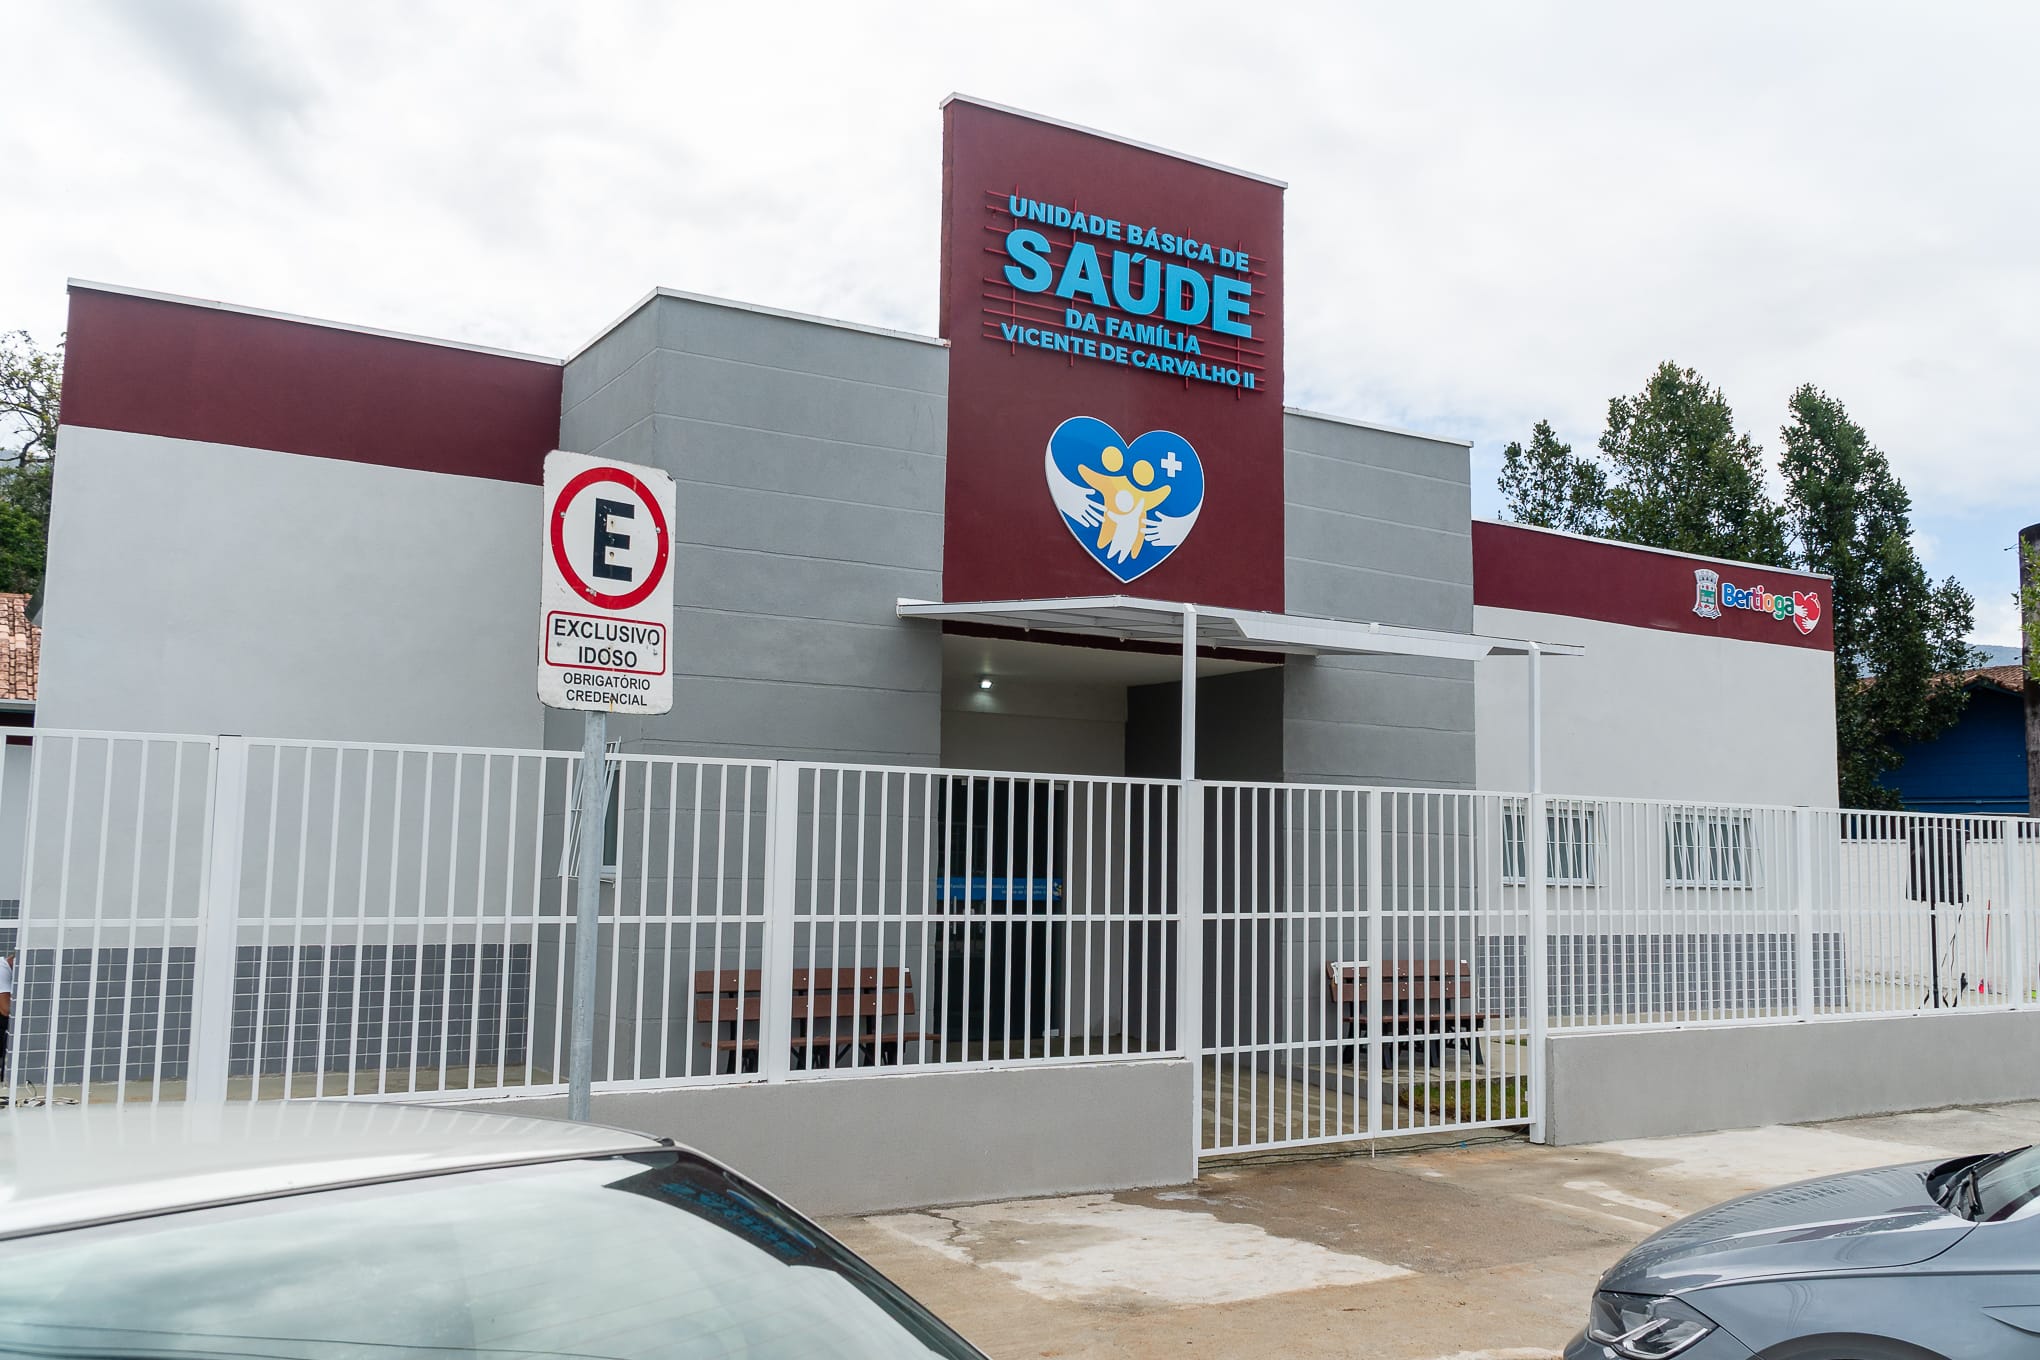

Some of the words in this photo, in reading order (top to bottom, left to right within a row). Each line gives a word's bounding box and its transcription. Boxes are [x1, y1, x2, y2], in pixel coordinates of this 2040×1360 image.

[1009, 195, 1121, 241] UNIDADE
[1127, 224, 1214, 264] BÁSICA
[1219, 247, 1249, 272] DE
[1004, 229, 1252, 338] SAÚDE
[1065, 308, 1100, 334] DA
[1105, 316, 1201, 355] FAMÍLIA
[1001, 322, 1097, 358] VICENTE
[1099, 343, 1128, 365] DE
[1131, 350, 1241, 386] CARVALHO
[1243, 372, 1255, 389] II
[592, 497, 635, 582] E
[1722, 583, 1795, 620] Bertioga
[554, 618, 660, 646] EXCLUSIVO
[578, 646, 637, 668] IDOSO
[563, 672, 651, 691] OBRIGATÓRIO
[566, 689, 648, 706] CREDENCIAL
